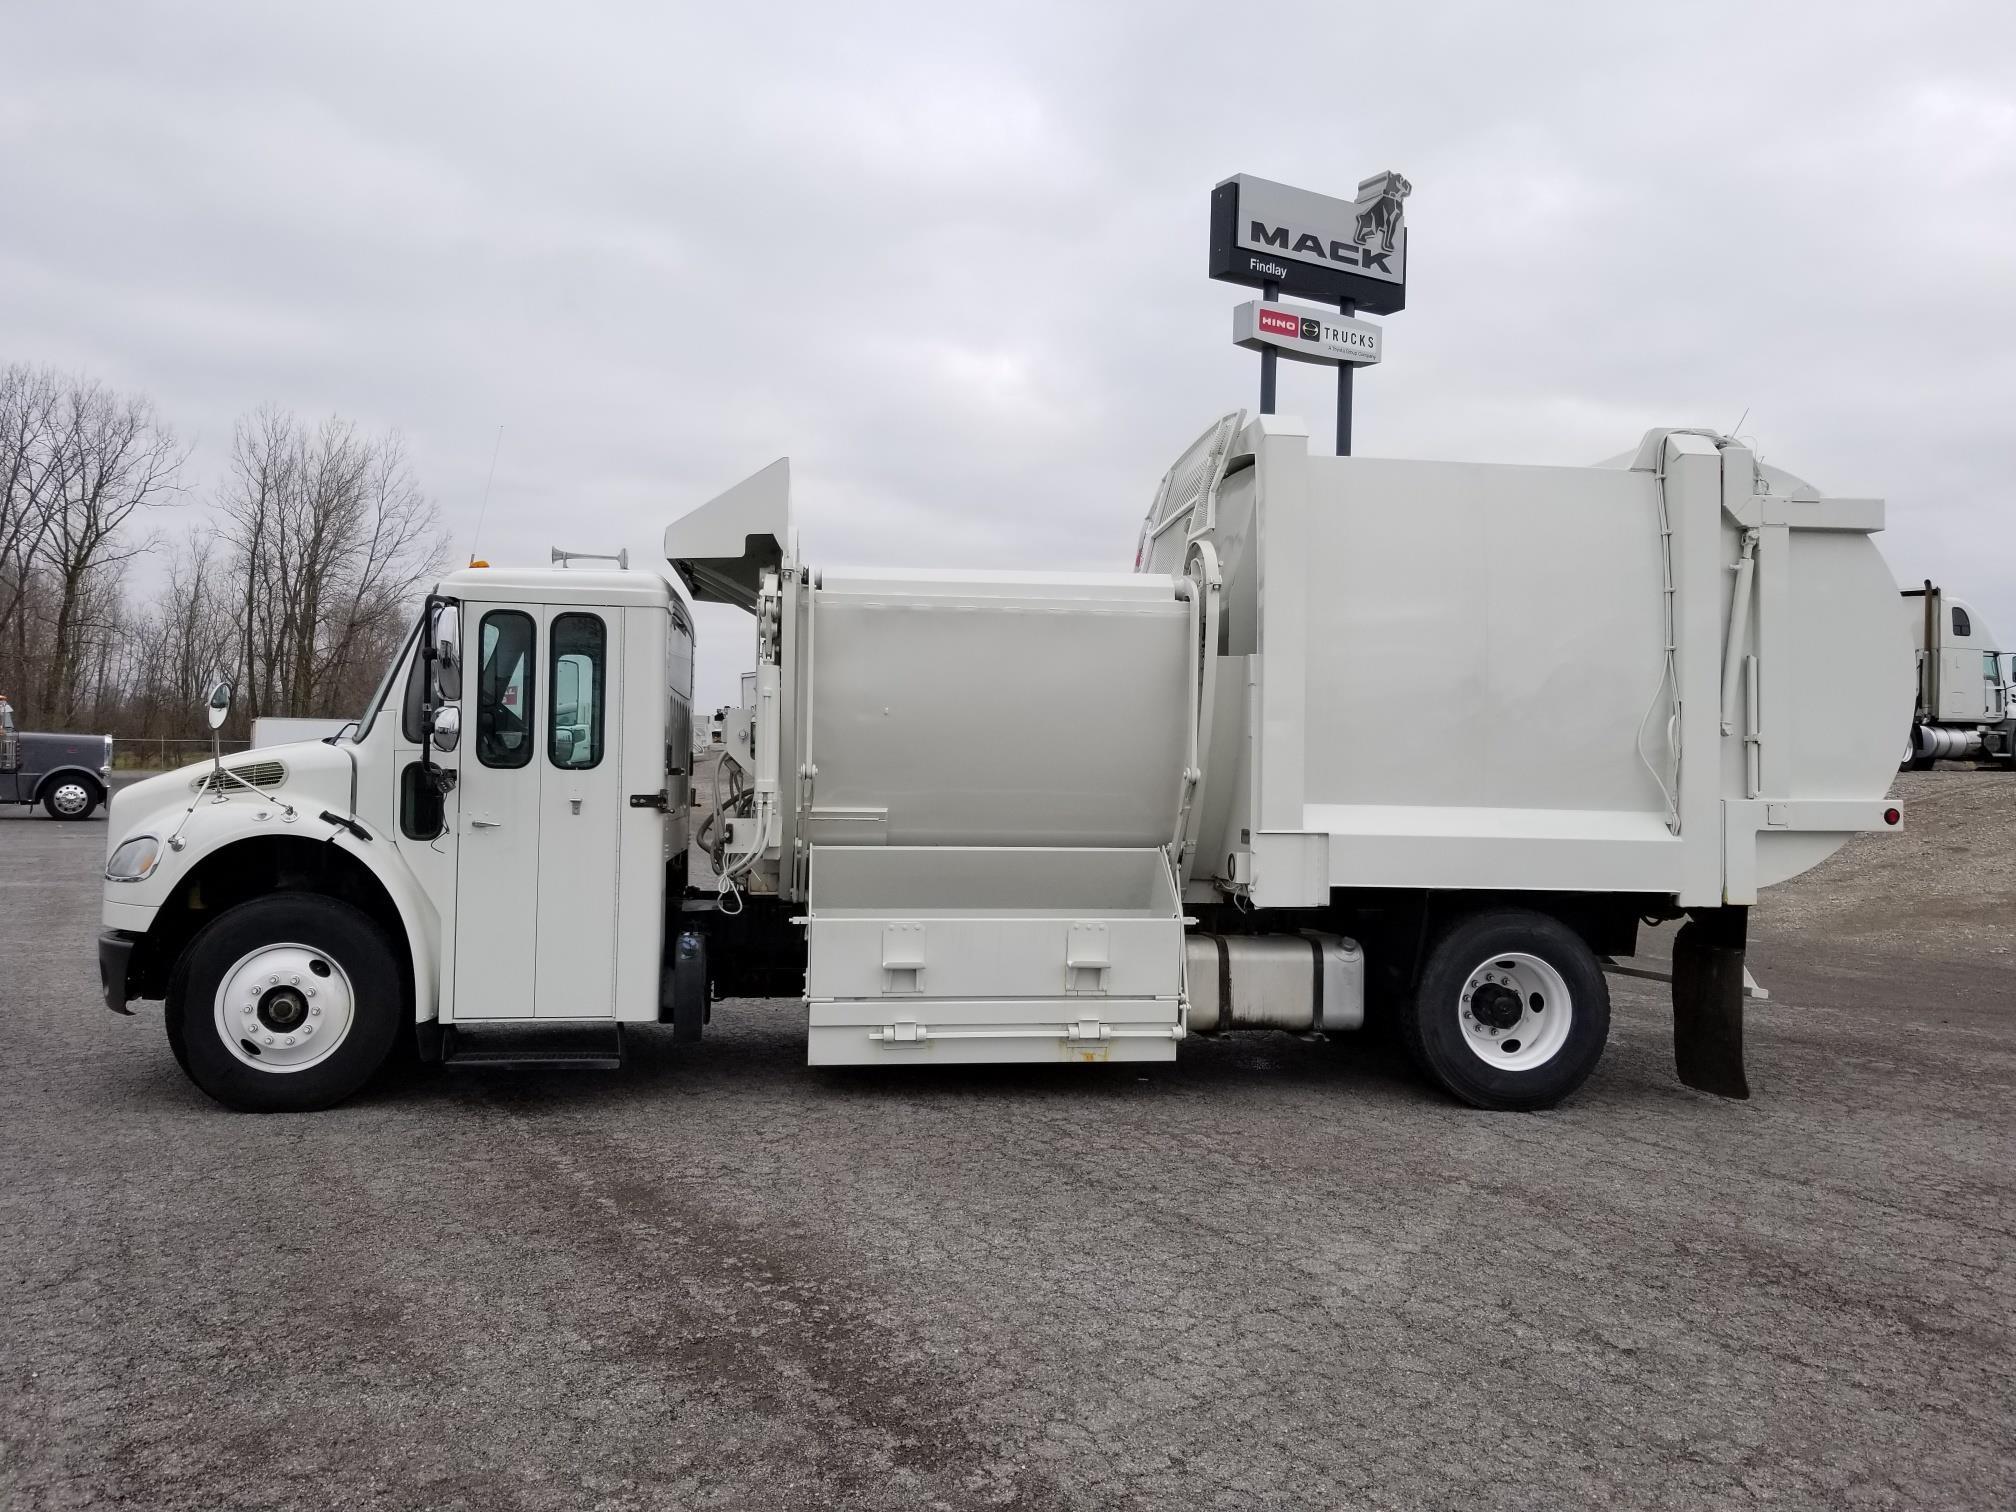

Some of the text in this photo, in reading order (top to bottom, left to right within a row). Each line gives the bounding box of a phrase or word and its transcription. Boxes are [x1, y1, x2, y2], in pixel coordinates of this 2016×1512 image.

[1251, 220, 1393, 274] MACK
[1250, 258, 1287, 278] Findlay
[1262, 317, 1374, 349] HINO TRUCKS
